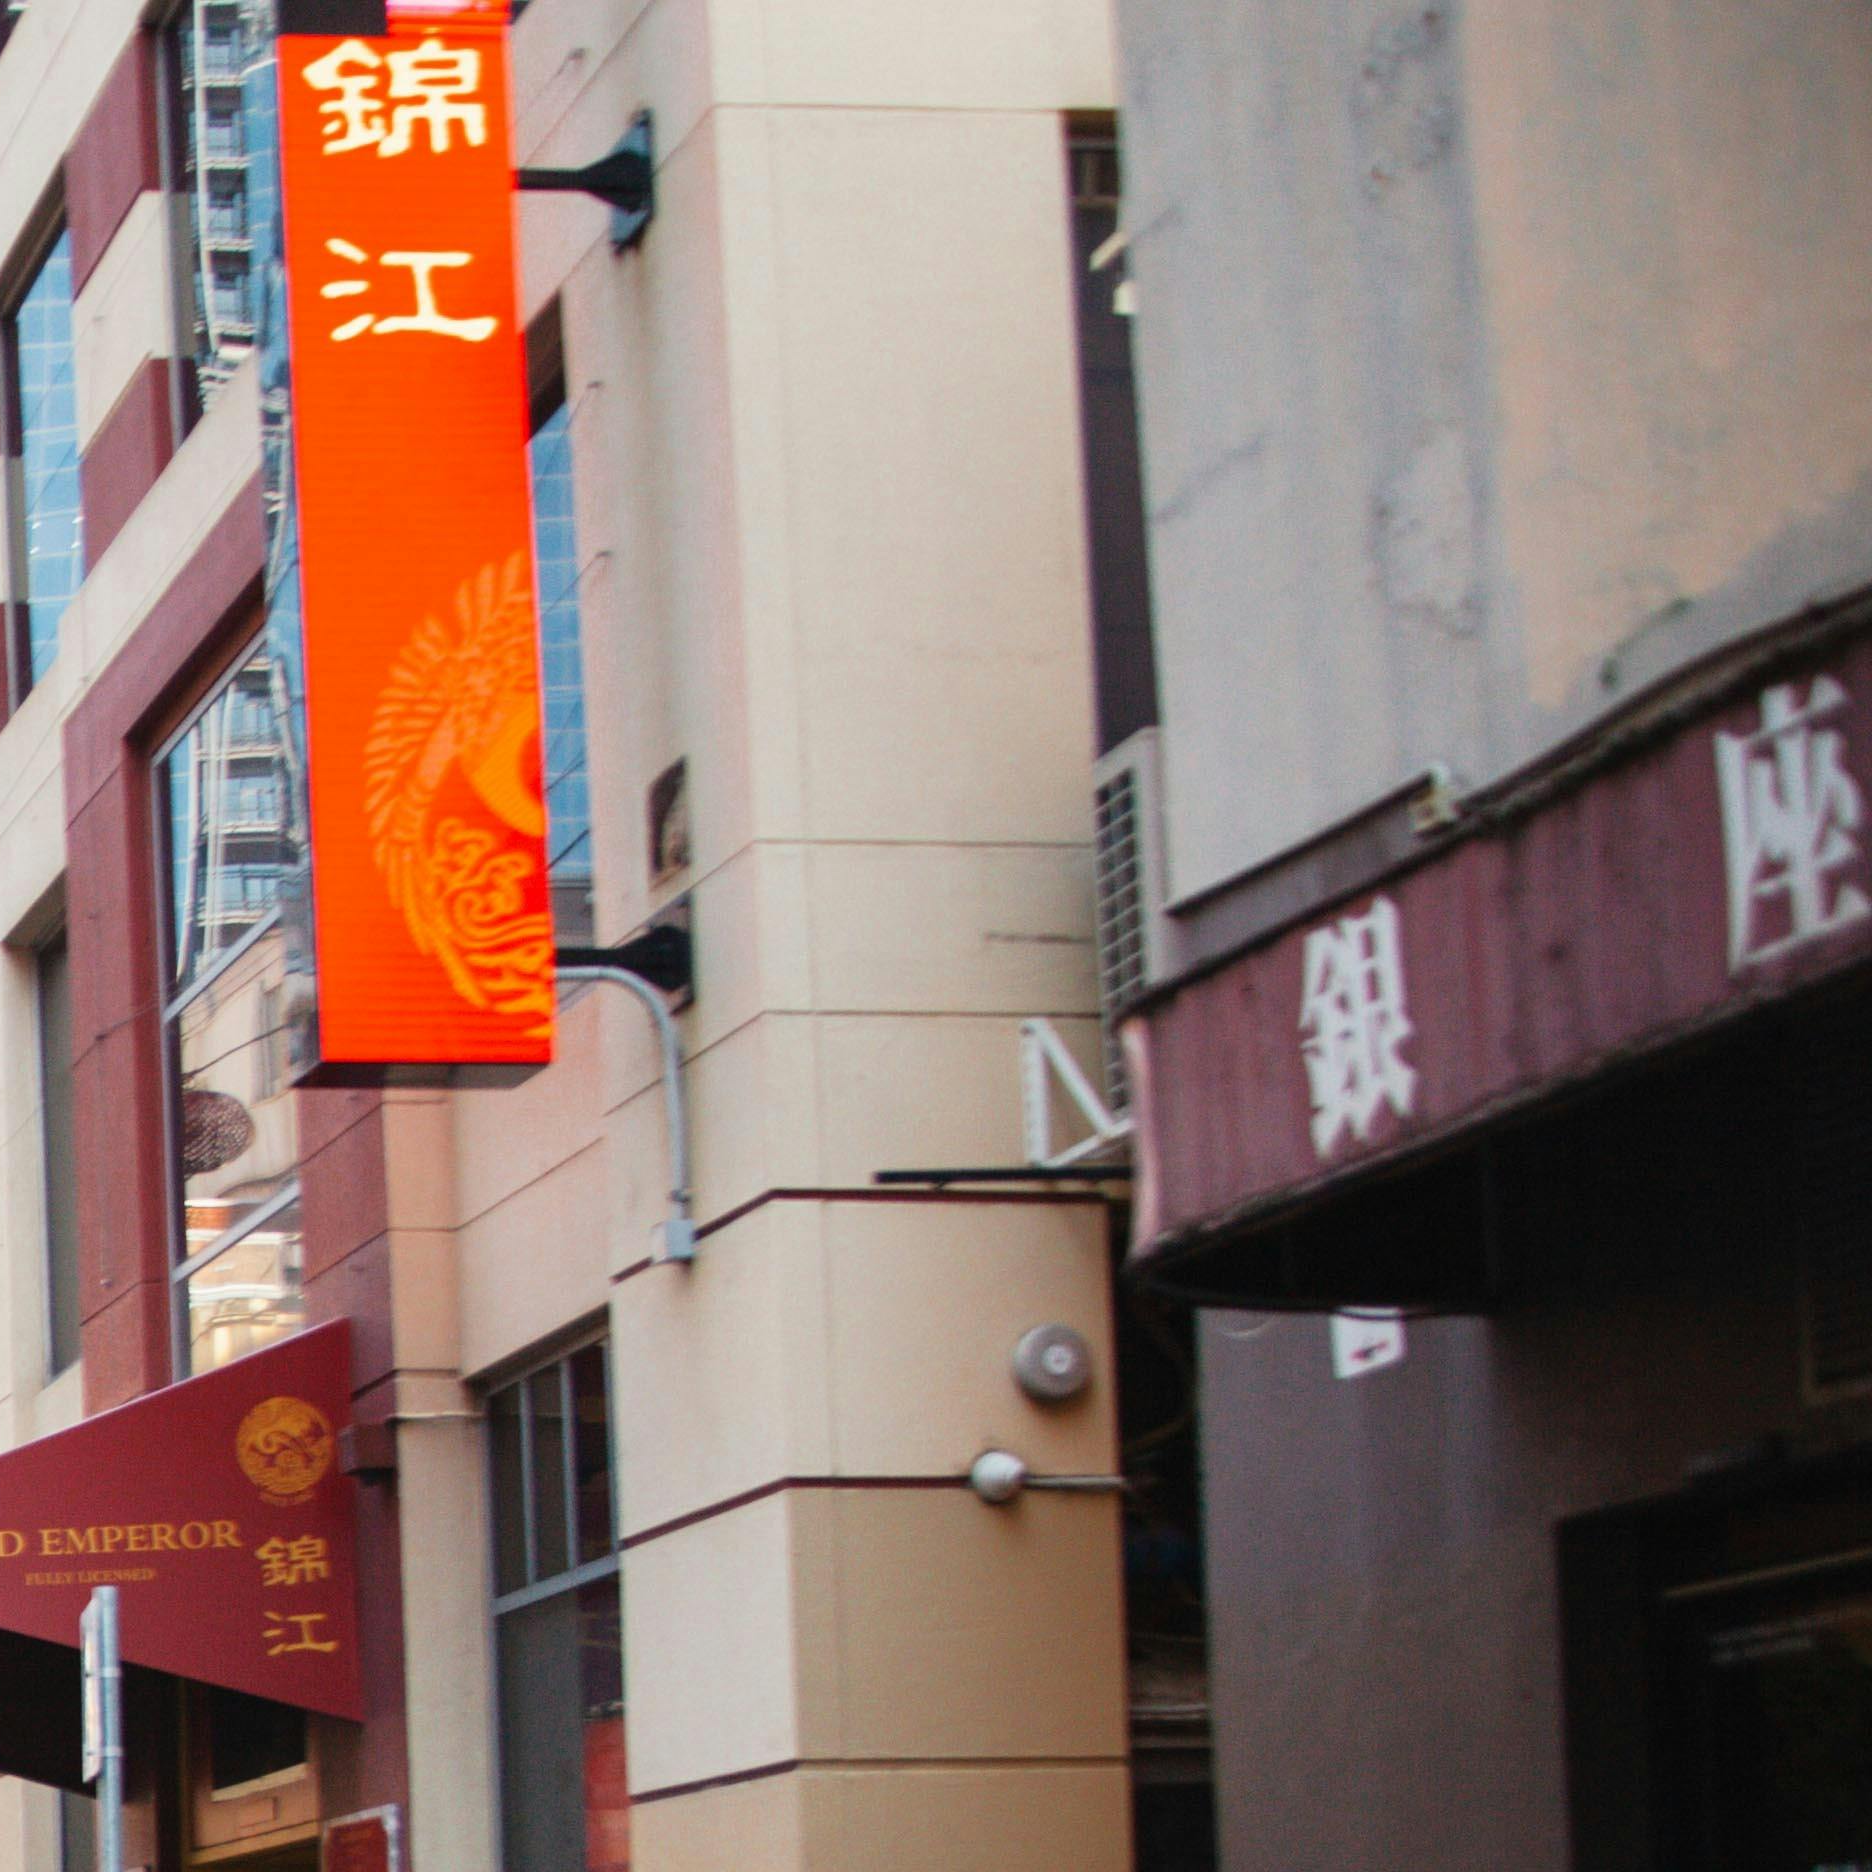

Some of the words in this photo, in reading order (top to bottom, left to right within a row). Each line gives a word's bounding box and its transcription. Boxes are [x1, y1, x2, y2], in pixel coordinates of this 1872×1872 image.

[302, 38, 499, 343] 錦江
[25, 1571, 74, 1586] FULLY
[78, 1568, 156, 1584] LICENSED
[39, 1520, 242, 1556] EMPEROR
[255, 1534, 339, 1657] 錦江
